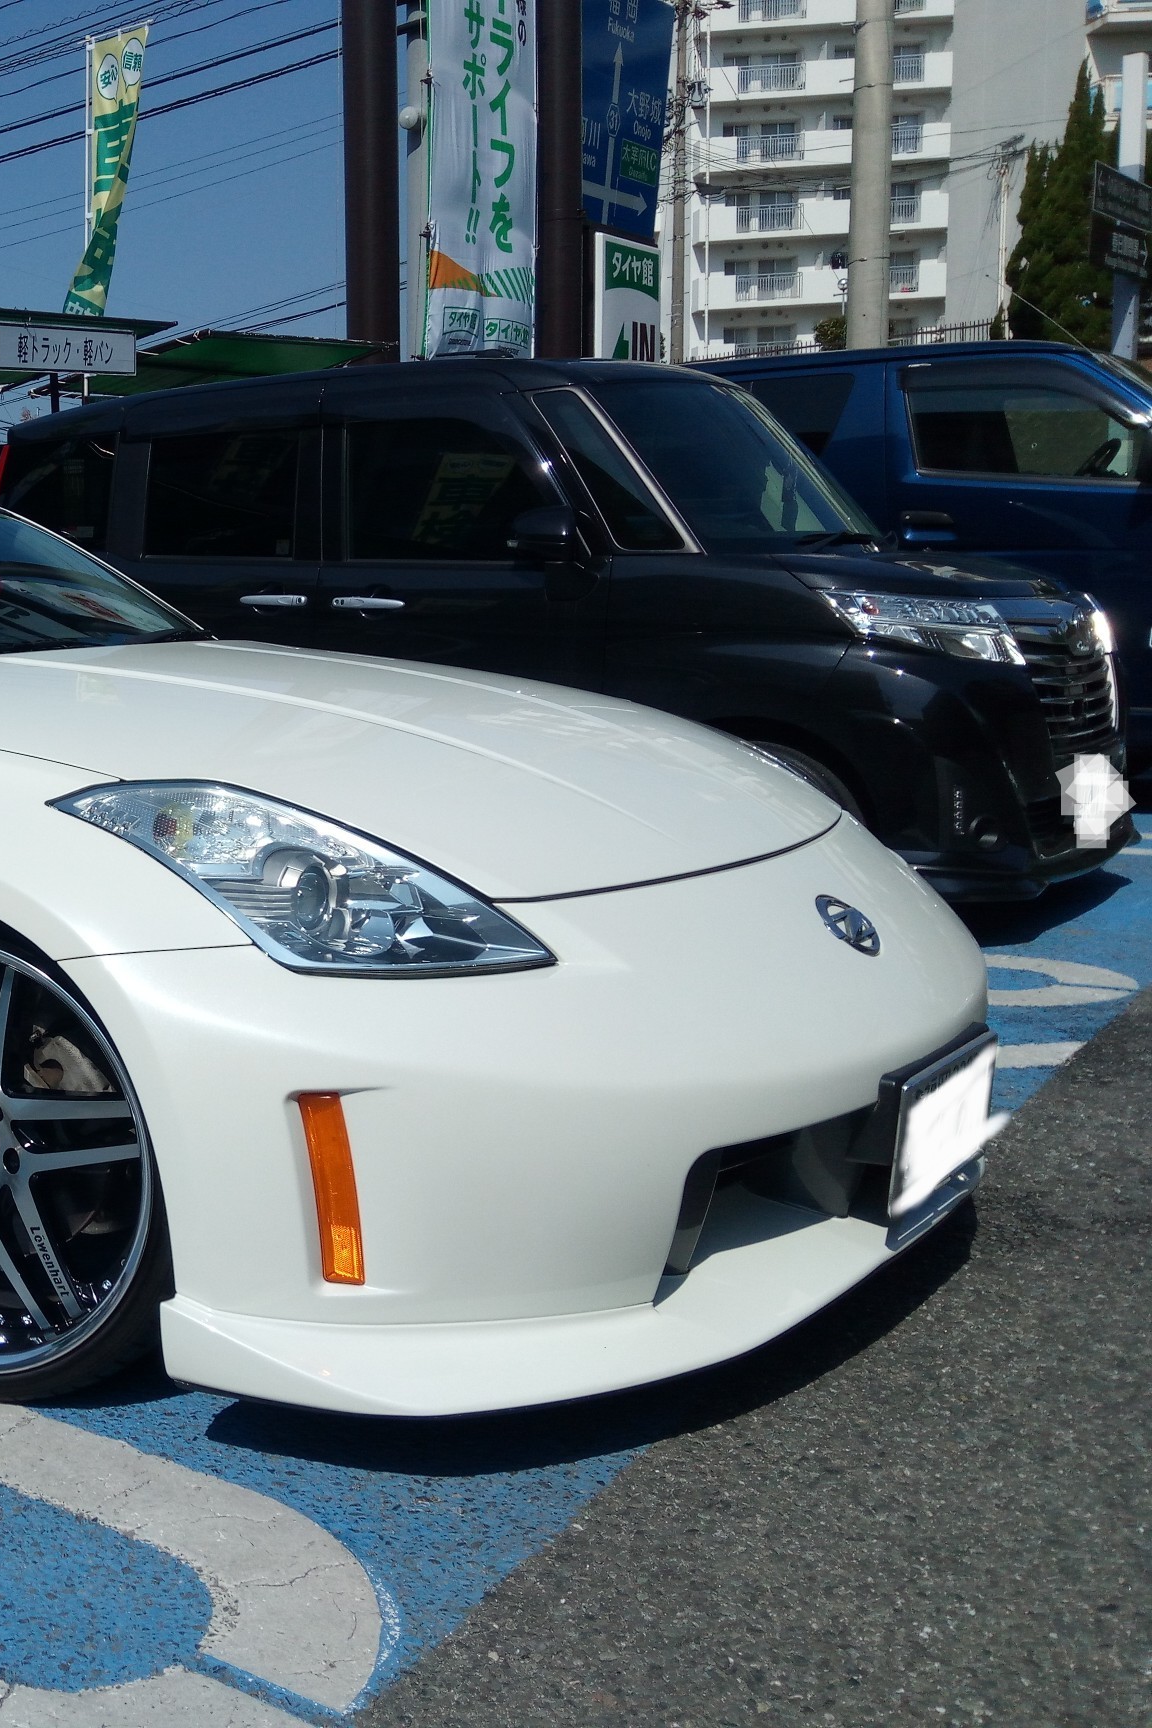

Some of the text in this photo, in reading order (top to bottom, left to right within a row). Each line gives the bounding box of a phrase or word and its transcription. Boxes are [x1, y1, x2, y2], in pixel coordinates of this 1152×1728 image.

[607, 16, 635, 43] Fukuoka
[100, 65, 118, 89] 安心
[123, 51, 143, 72] 信頼
[626, 88, 663, 126] 大野城
[633, 120, 652, 142] Onojo
[612, 251, 654, 287] タイヤ館
[17, 333, 114, 366] 軽トラック・軽バン
[632, 321, 655, 362] IN
[30, 1226, 71, 1297] Löwenhart
